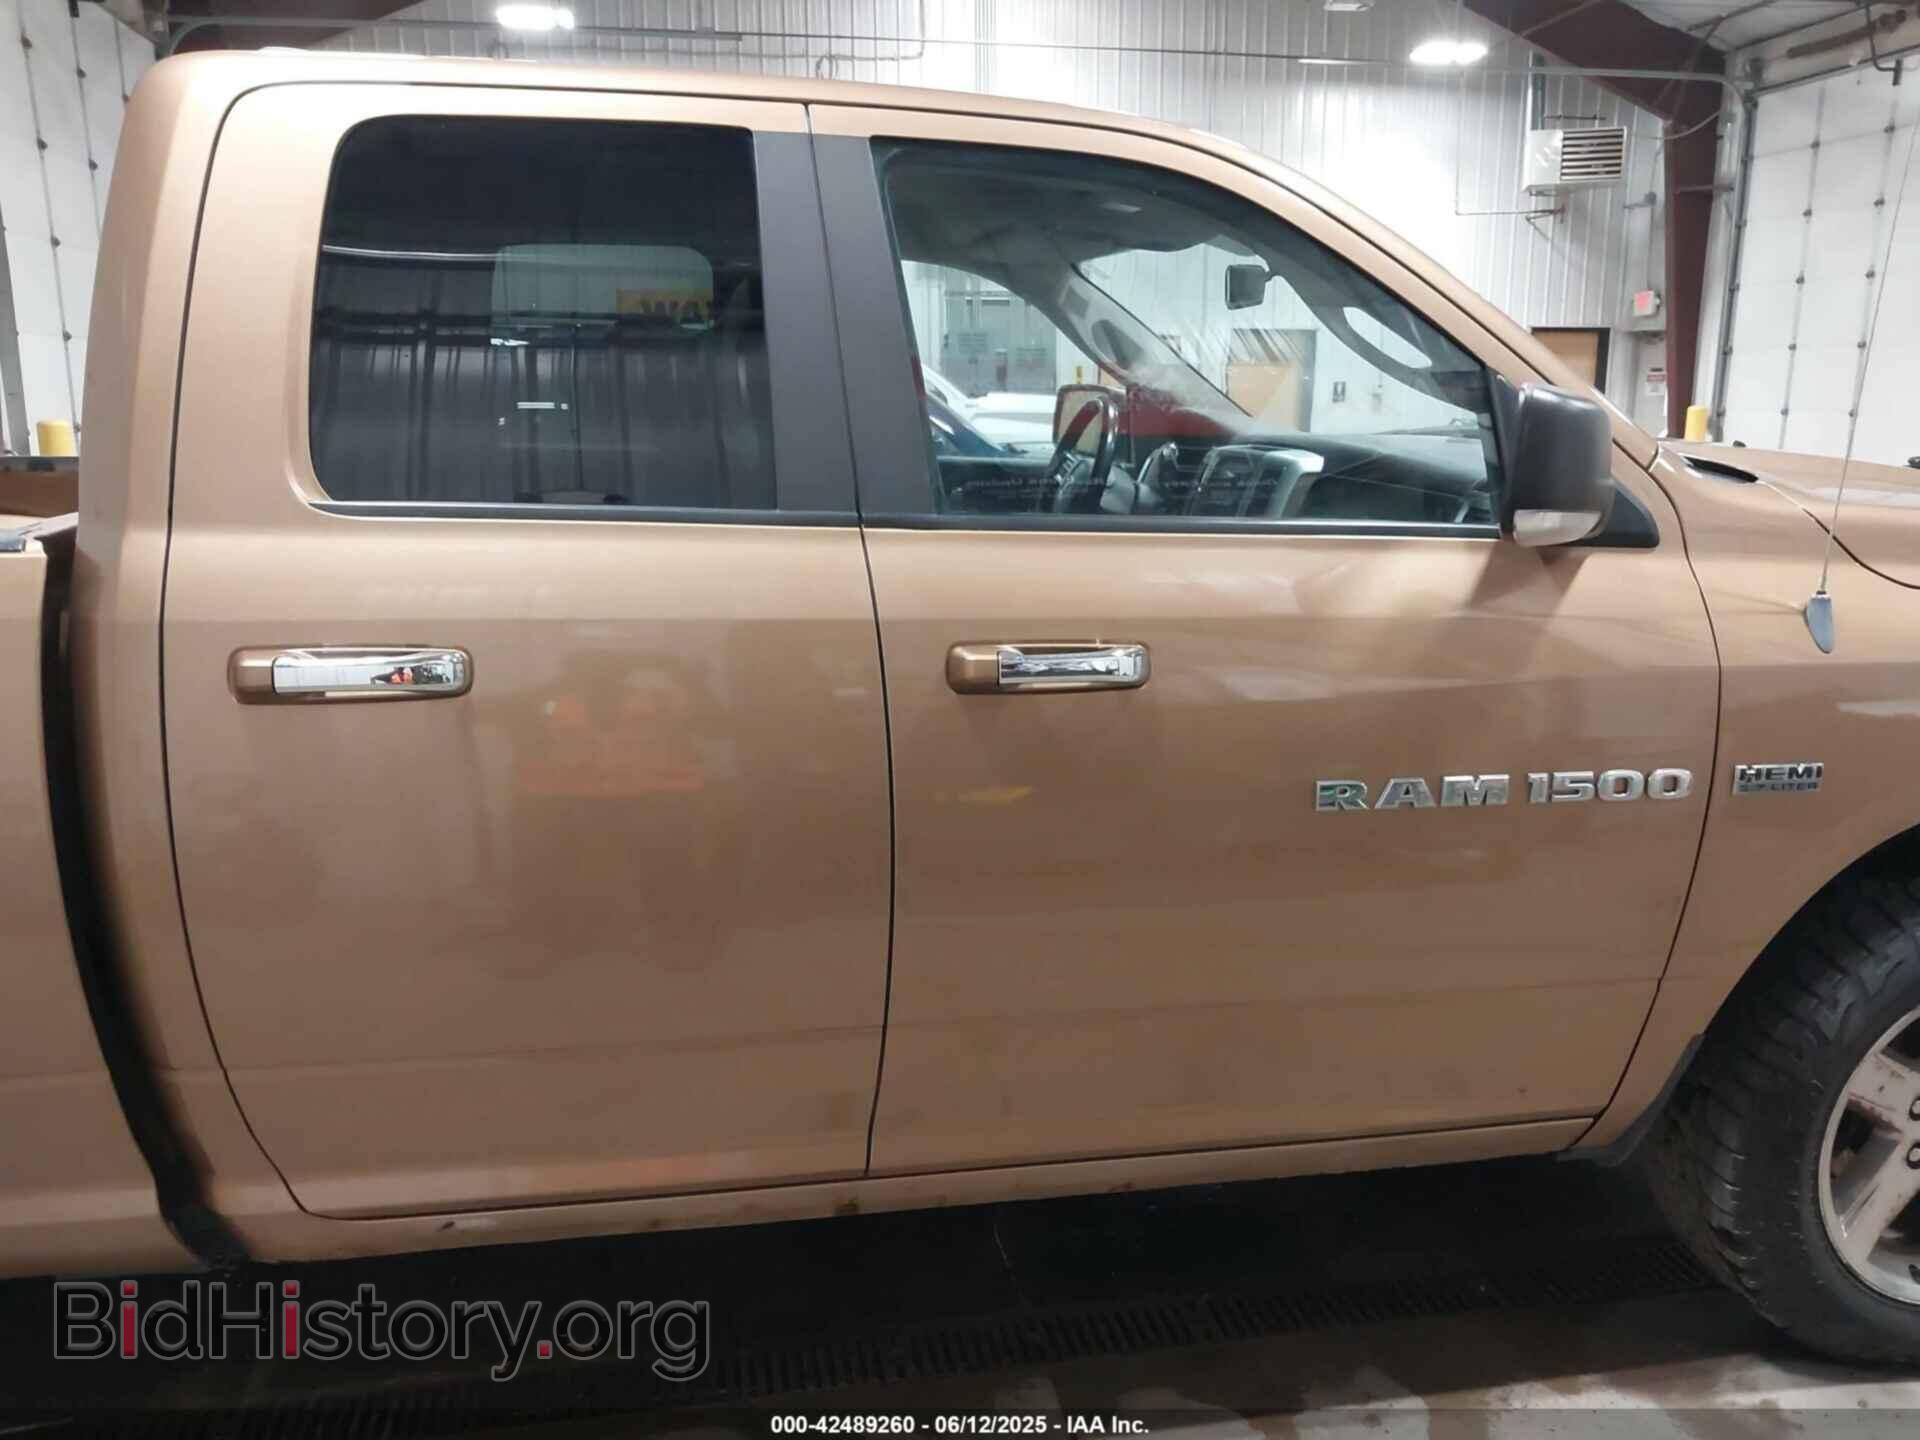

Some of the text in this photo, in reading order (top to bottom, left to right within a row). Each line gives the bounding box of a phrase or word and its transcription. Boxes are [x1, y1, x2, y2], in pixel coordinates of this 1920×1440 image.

[1735, 763, 1824, 782] HEMI
[1315, 767, 1694, 812] RAM 1500
